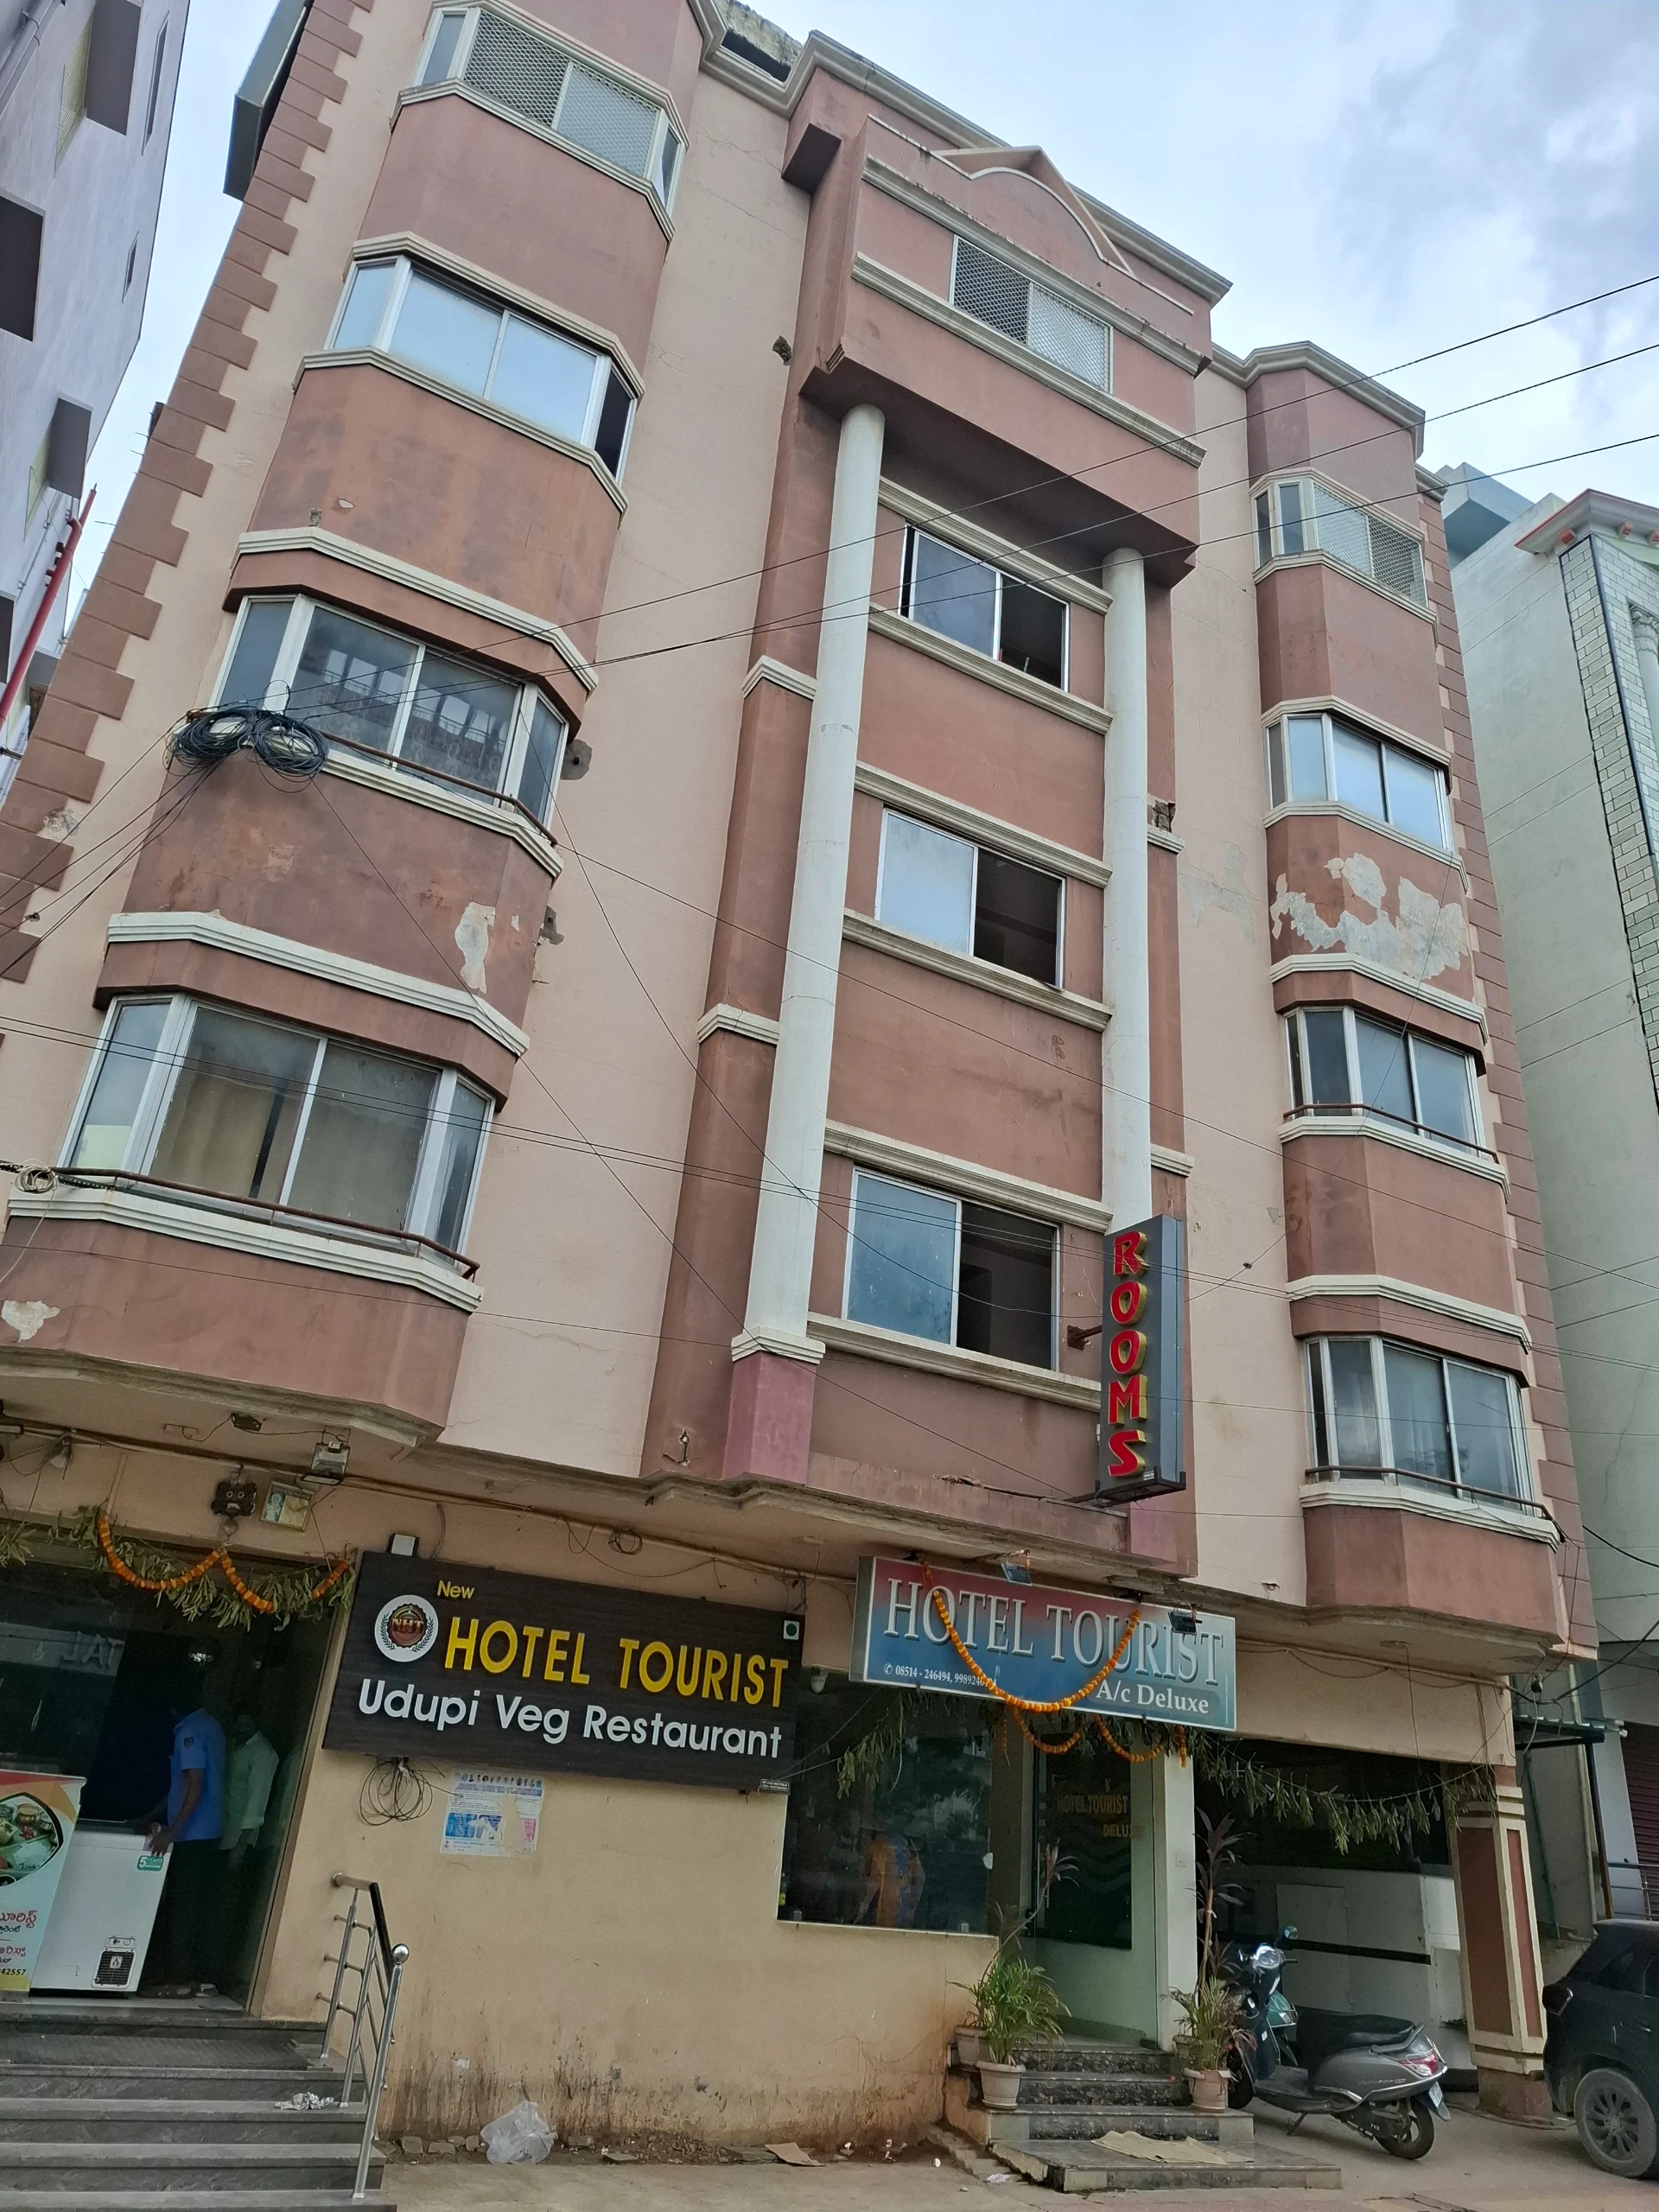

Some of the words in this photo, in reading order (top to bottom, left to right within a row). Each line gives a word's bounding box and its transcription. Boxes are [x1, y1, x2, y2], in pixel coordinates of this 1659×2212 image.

[1108, 1230, 1149, 1478] ROOMS
[436, 1580, 474, 1600] New
[391, 1618, 424, 1630] NHT
[884, 1578, 1033, 1657] HOTEL
[1046, 1605, 1224, 1686] TOURIST
[444, 1617, 590, 1685] HOTEL
[619, 1638, 788, 1707] TOURIST
[895, 1665, 918, 1678] 08514
[925, 1669, 952, 1683] 246494,
[1096, 1679, 1130, 1702] A/c
[1136, 1684, 1209, 1713] Deluxe
[358, 1678, 480, 1731] Udupi
[496, 1694, 570, 1745] Veg
[583, 1705, 782, 1758] Restaurant
[1057, 1795, 1086, 1814] HOTEL
[1087, 1795, 1128, 1814] TOURIST
[1103, 1824, 1132, 1838] DELU
[139, 1857, 147, 1867] 5
